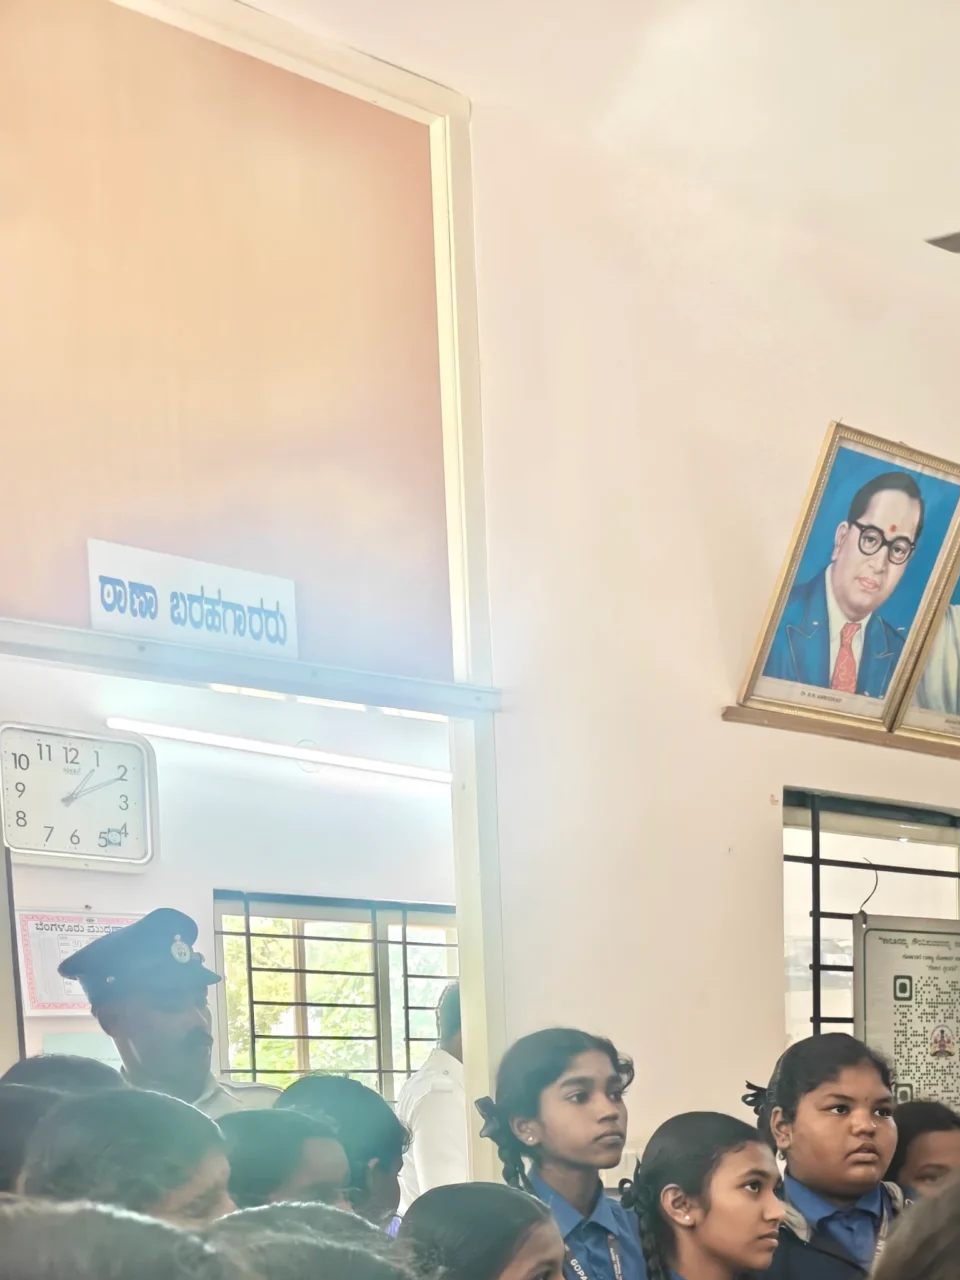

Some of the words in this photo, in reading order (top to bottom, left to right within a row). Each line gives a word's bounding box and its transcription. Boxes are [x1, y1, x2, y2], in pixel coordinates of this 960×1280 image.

[170, 585, 288, 645] ಬರಹಗಾರರು
[37, 743, 52, 761] 11
[62, 746, 80, 764] 12
[93, 750, 100, 767] 1
[11, 752, 30, 771] 10
[117, 764, 128, 781] 2
[15, 782, 26, 798] 9
[119, 794, 129, 810] 3
[16, 810, 27, 827] 8
[43, 825, 55, 842] 7
[69, 829, 80, 845] 6
[119, 822, 129, 838] 4
[97, 831, 108, 848] 5
